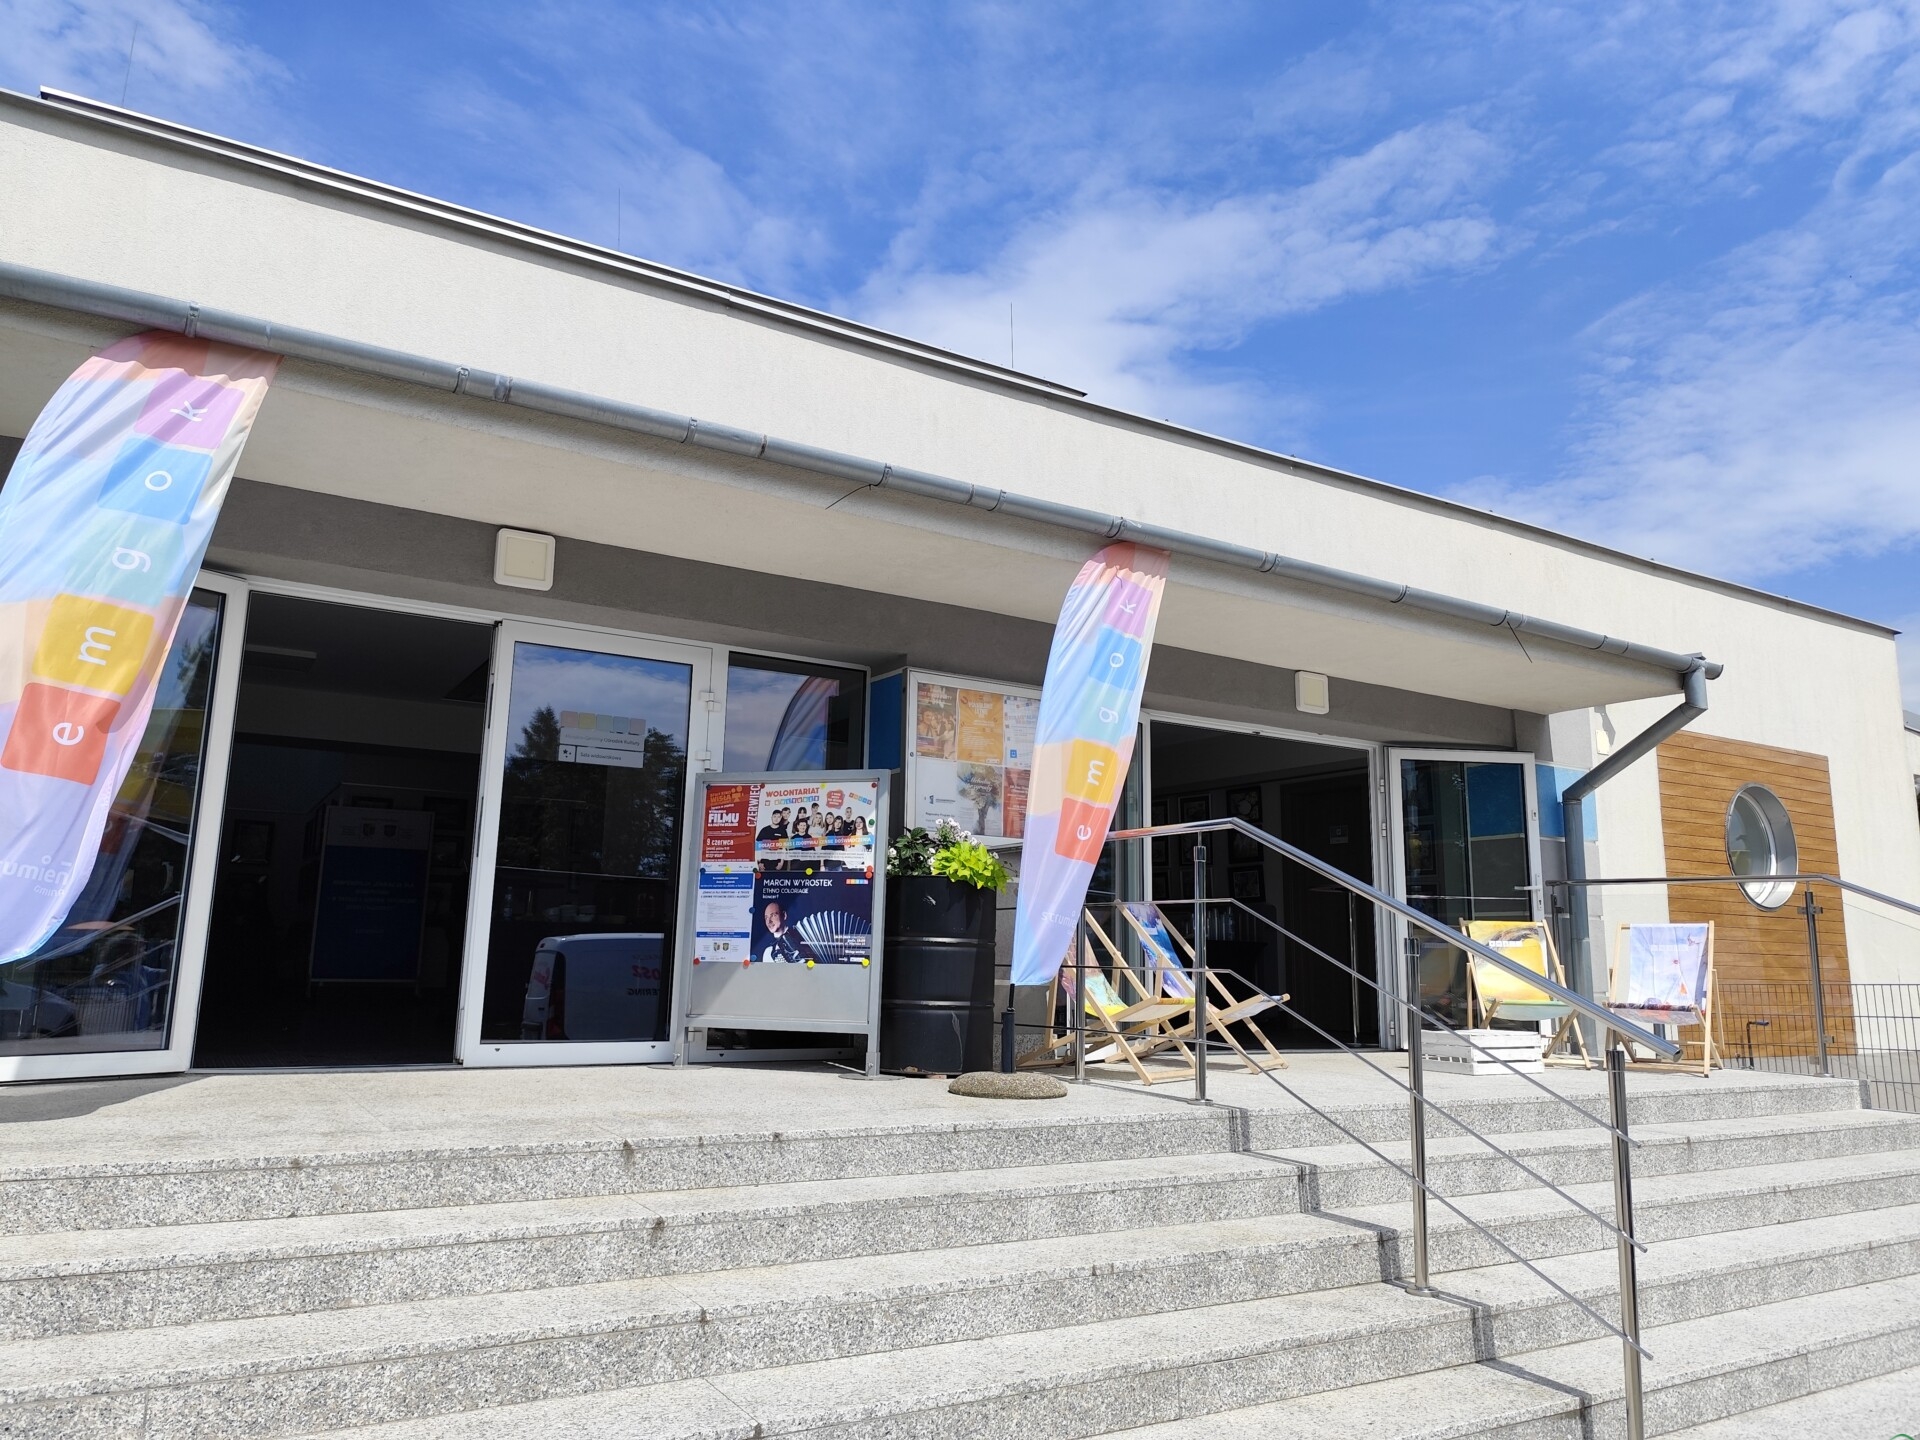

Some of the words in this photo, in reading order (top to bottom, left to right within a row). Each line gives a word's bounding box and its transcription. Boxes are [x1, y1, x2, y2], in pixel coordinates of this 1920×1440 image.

[766, 787, 820, 797] WOLONTARIAT
[746, 785, 761, 827] CZERWIEC
[708, 812, 740, 823] FILMU
[763, 878, 791, 887] MARCIN
[792, 878, 833, 887] WYROSTEK
[1041, 910, 1078, 929] strumie
